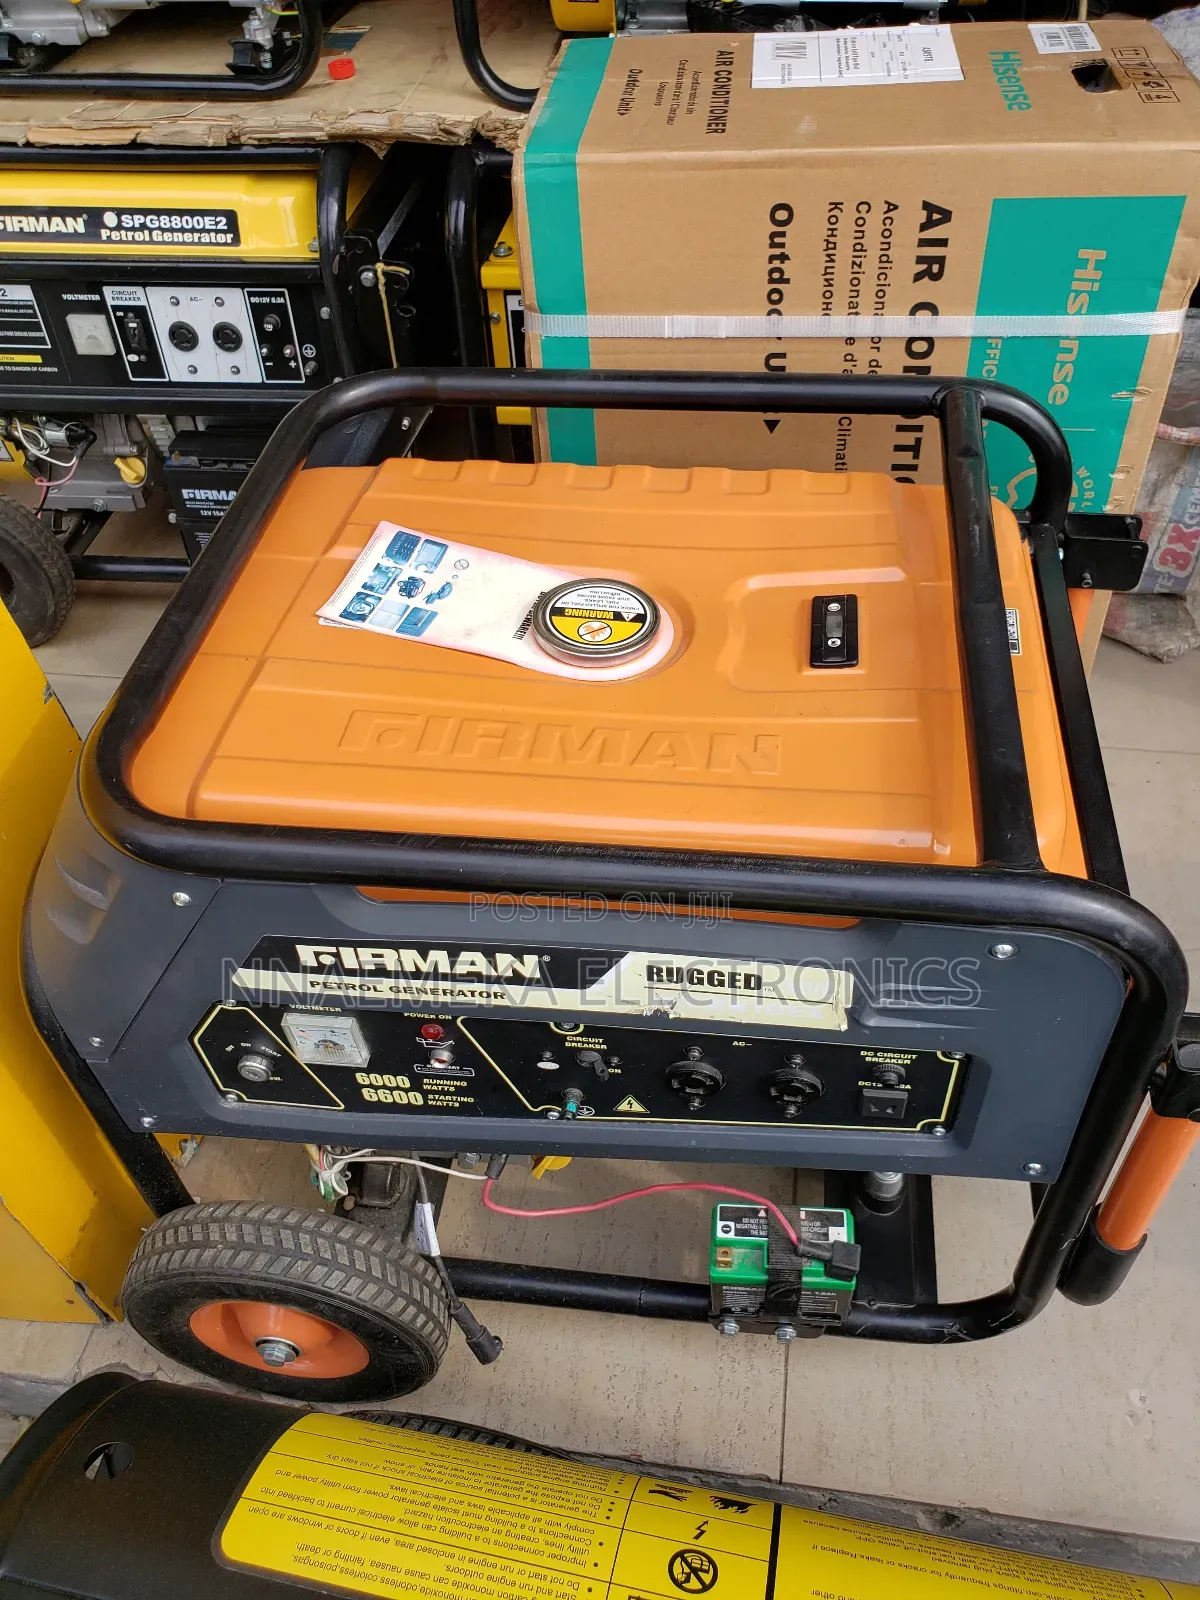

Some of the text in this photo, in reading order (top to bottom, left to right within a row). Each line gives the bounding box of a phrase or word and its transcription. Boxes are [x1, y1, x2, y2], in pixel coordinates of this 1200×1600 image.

[989, 50, 1033, 112] Hisense
[705, 50, 735, 135] AIR CONDITIONER
[617, 97, 636, 112] Unit
[0, 216, 86, 234] IRMAN
[121, 214, 228, 230] SPG8800E2
[101, 229, 234, 244] Petrol Generator
[912, 200, 953, 284] AIR
[564, 608, 614, 620] WARNING
[337, 709, 782, 776] FIRMAN
[295, 944, 541, 979] FIRMAN
[645, 964, 762, 991] RUGGED
[309, 980, 507, 1000] PETROL GENERATOR
[289, 1004, 342, 1012] VOLTMETER
[566, 1035, 604, 1044] CIRCUIT
[565, 1042, 607, 1050] BREAKER
[865, 1056, 911, 1065] BREAKER
[876, 1051, 918, 1060] CIRCUIT
[355, 1072, 411, 1088] 6000
[423, 1078, 468, 1087] RUNNING
[361, 1087, 424, 1106] 6600
[427, 1094, 475, 1103] STARTING
[292, 1474, 321, 1483] power
[319, 1478, 341, 1487] utility
[261, 1487, 276, 1496] into
[343, 1484, 361, 1493] from
[363, 1489, 389, 1498] power
[277, 1491, 315, 1505] backfeed
[391, 1495, 431, 1508] generator
[410, 1490, 446, 1501] electrical
[327, 1502, 356, 1512] current
[433, 1504, 460, 1516] isolate
[467, 1502, 485, 1512] laws
[357, 1509, 395, 1522] electrical
[462, 1511, 482, 1519] must
[488, 1507, 530, 1520] applicable
[287, 1515, 322, 1528] windows
[397, 1518, 419, 1528] allow
[422, 1523, 436, 1531] can
[436, 1516, 489, 1532] electrocution
[485, 1515, 518, 1529] building
[336, 1526, 360, 1538] doors
[439, 1526, 472, 1541] building
[564, 1523, 594, 1534] comply
[360, 1532, 367, 1540] if
[370, 1534, 390, 1543] even
[505, 1530, 539, 1543] creating
[539, 1528, 592, 1546] Connections
[416, 1545, 455, 1559] enclosed
[493, 1540, 544, 1556] connections
[567, 1544, 589, 1555] utility
[334, 1550, 365, 1566] fainting
[458, 1554, 466, 1563] in
[468, 1557, 497, 1569] engine
[547, 1553, 586, 1568] Improper
[500, 1564, 514, 1573] run
[898, 1563, 927, 1572] cracks
[405, 1569, 430, 1580] cause
[433, 1576, 449, 1584] can
[528, 1571, 548, 1581] start
[550, 1576, 564, 1585] not
[945, 1572, 990, 1587] frequently
[487, 1575, 516, 1587] engine
[519, 1582, 533, 1591] run
[567, 1580, 580, 1591] Do
[452, 1580, 494, 1596] monoxide
[536, 1586, 553, 1596] and
[811, 1590, 835, 1599] other
